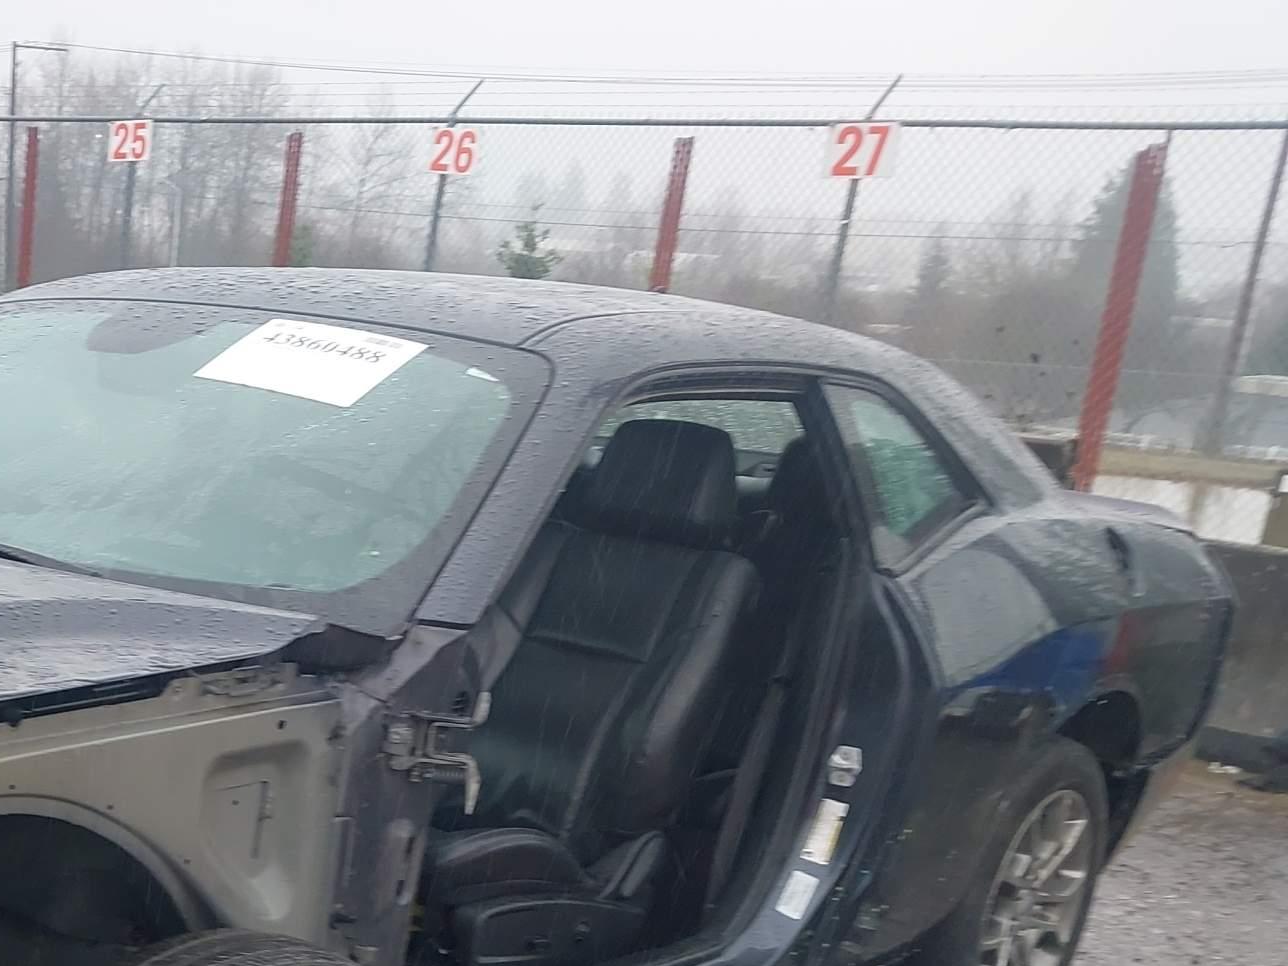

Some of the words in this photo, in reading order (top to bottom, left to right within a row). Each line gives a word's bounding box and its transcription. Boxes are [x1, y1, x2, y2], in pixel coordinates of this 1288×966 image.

[113, 122, 146, 160] 25
[429, 129, 476, 173] 26
[830, 125, 889, 177] 27
[262, 331, 388, 365] 43860488
